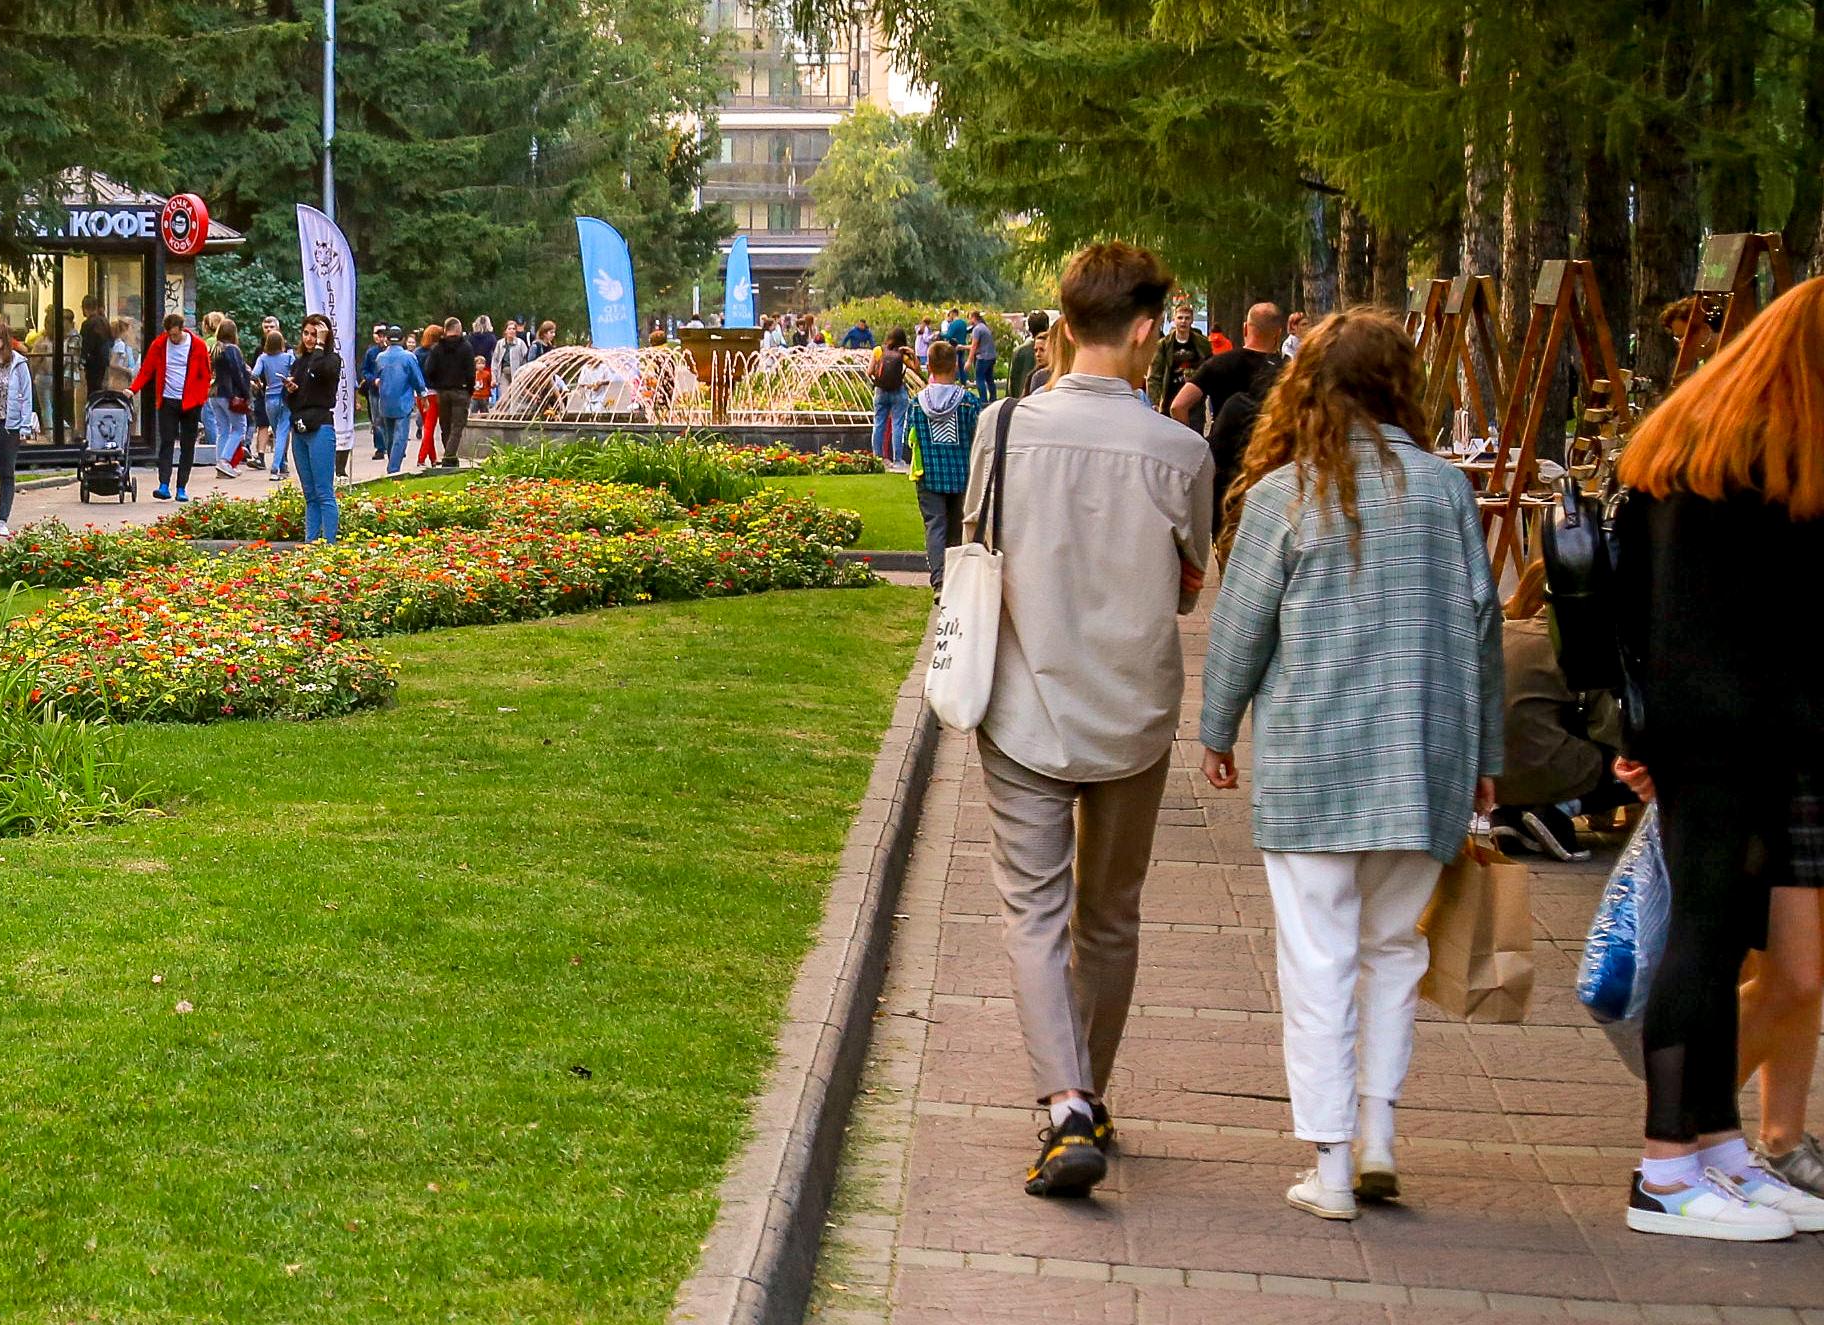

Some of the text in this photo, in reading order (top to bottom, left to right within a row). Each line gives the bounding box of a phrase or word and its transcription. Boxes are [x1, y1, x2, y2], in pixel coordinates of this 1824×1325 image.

[166, 199, 193, 215] ТОЧКА
[69, 210, 156, 238] КОФЕ
[169, 237, 192, 250] КОФЕ
